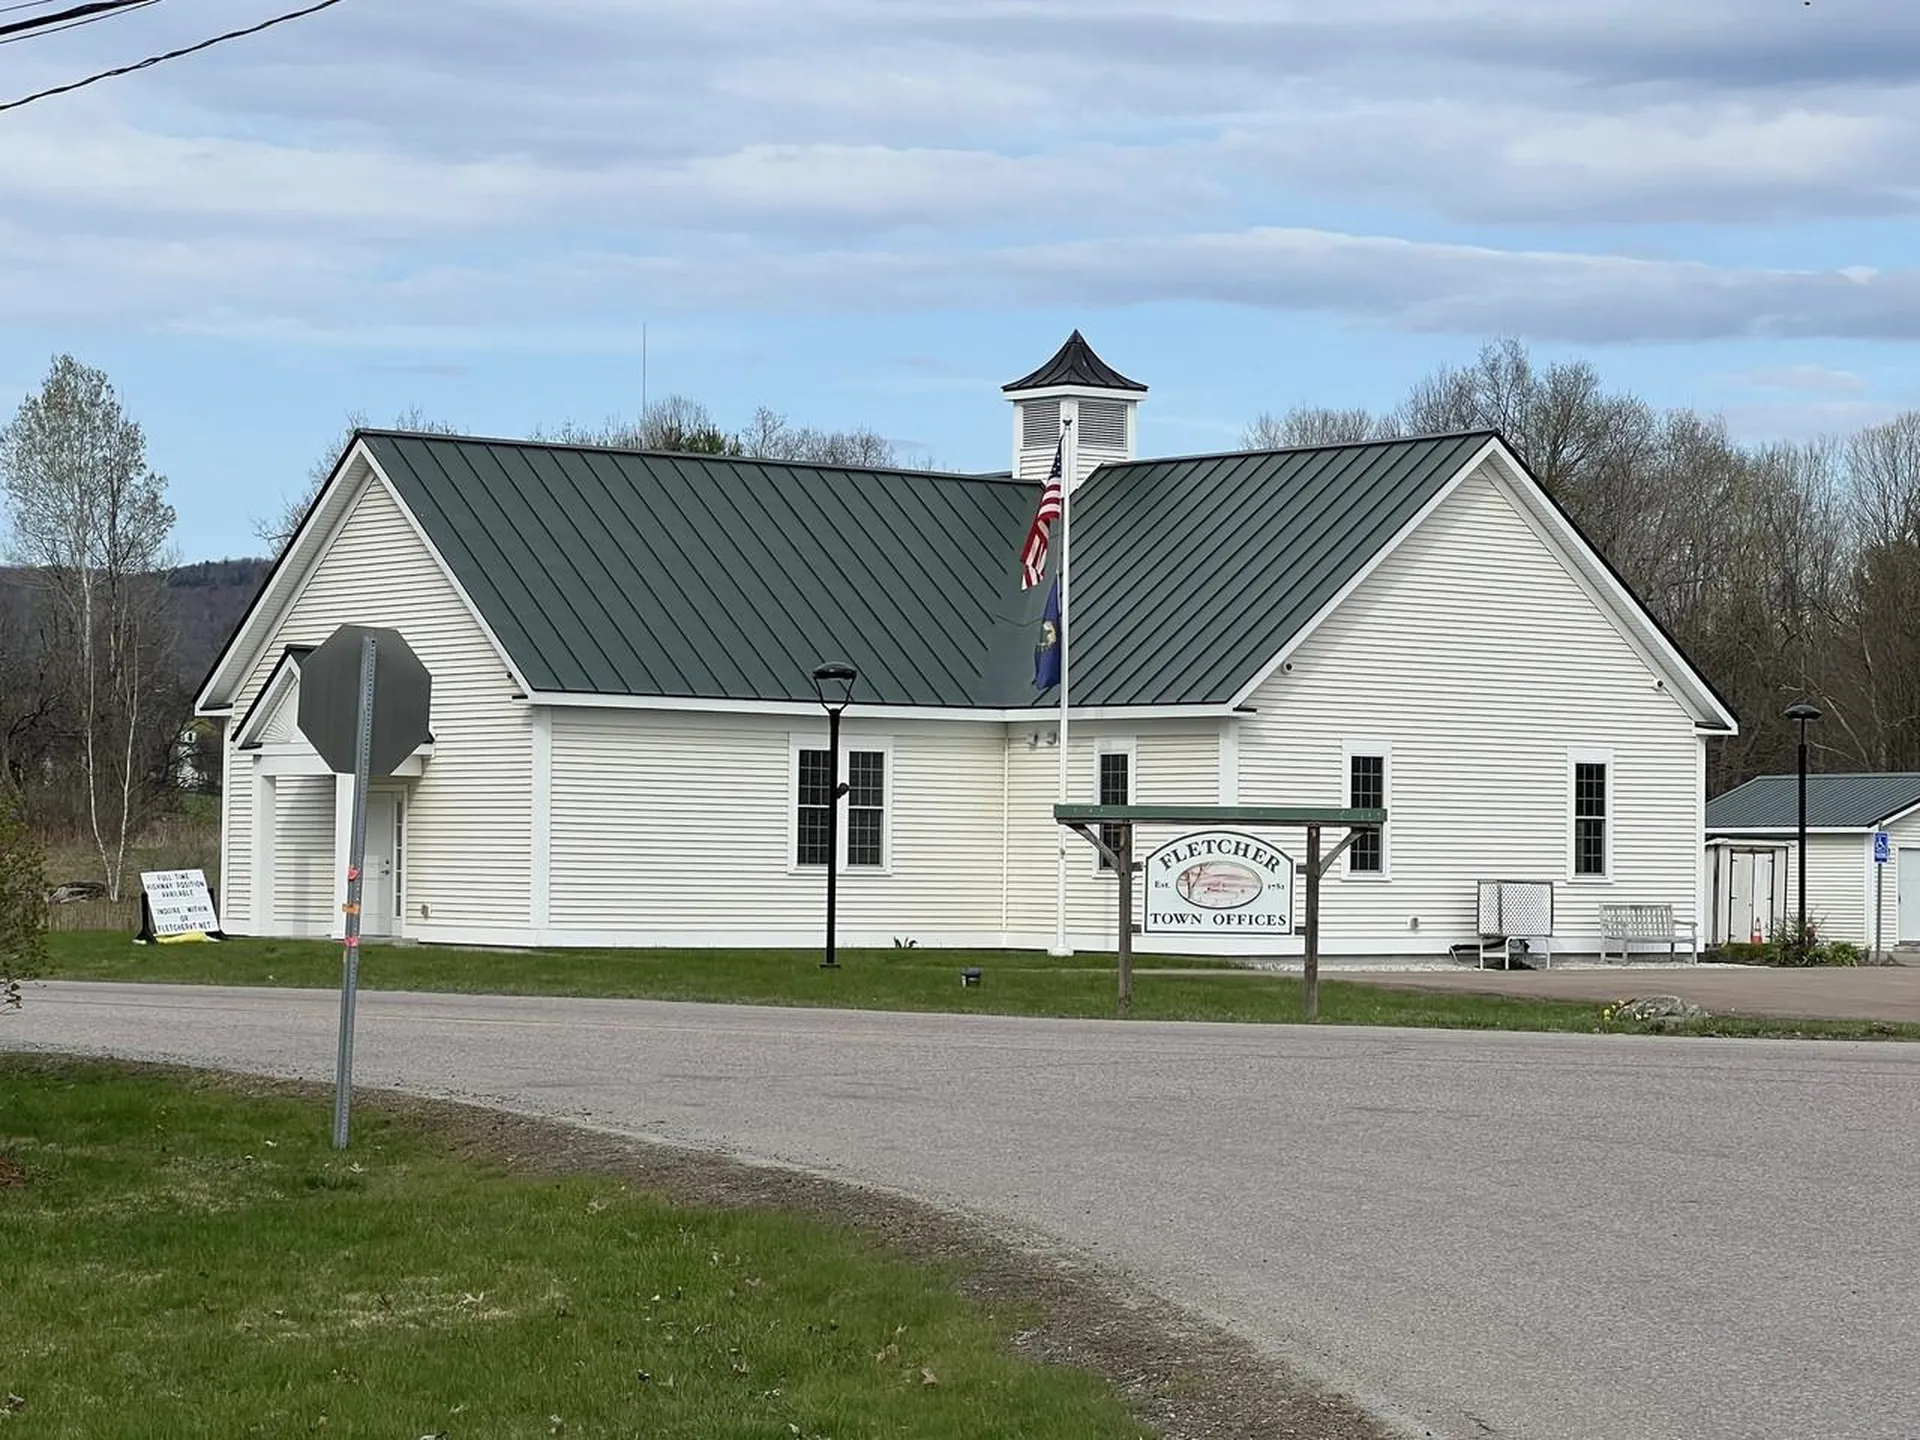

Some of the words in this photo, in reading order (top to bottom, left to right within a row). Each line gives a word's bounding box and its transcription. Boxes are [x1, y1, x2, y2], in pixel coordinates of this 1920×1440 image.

[1159, 839, 1280, 874] FLETCHER
[176, 880, 205, 889] POSITION
[1154, 881, 1171, 889] Est.
[161, 890, 193, 898] AVAILABLE
[1150, 913, 1202, 925] TOWN
[1213, 913, 1287, 926] OFFICES
